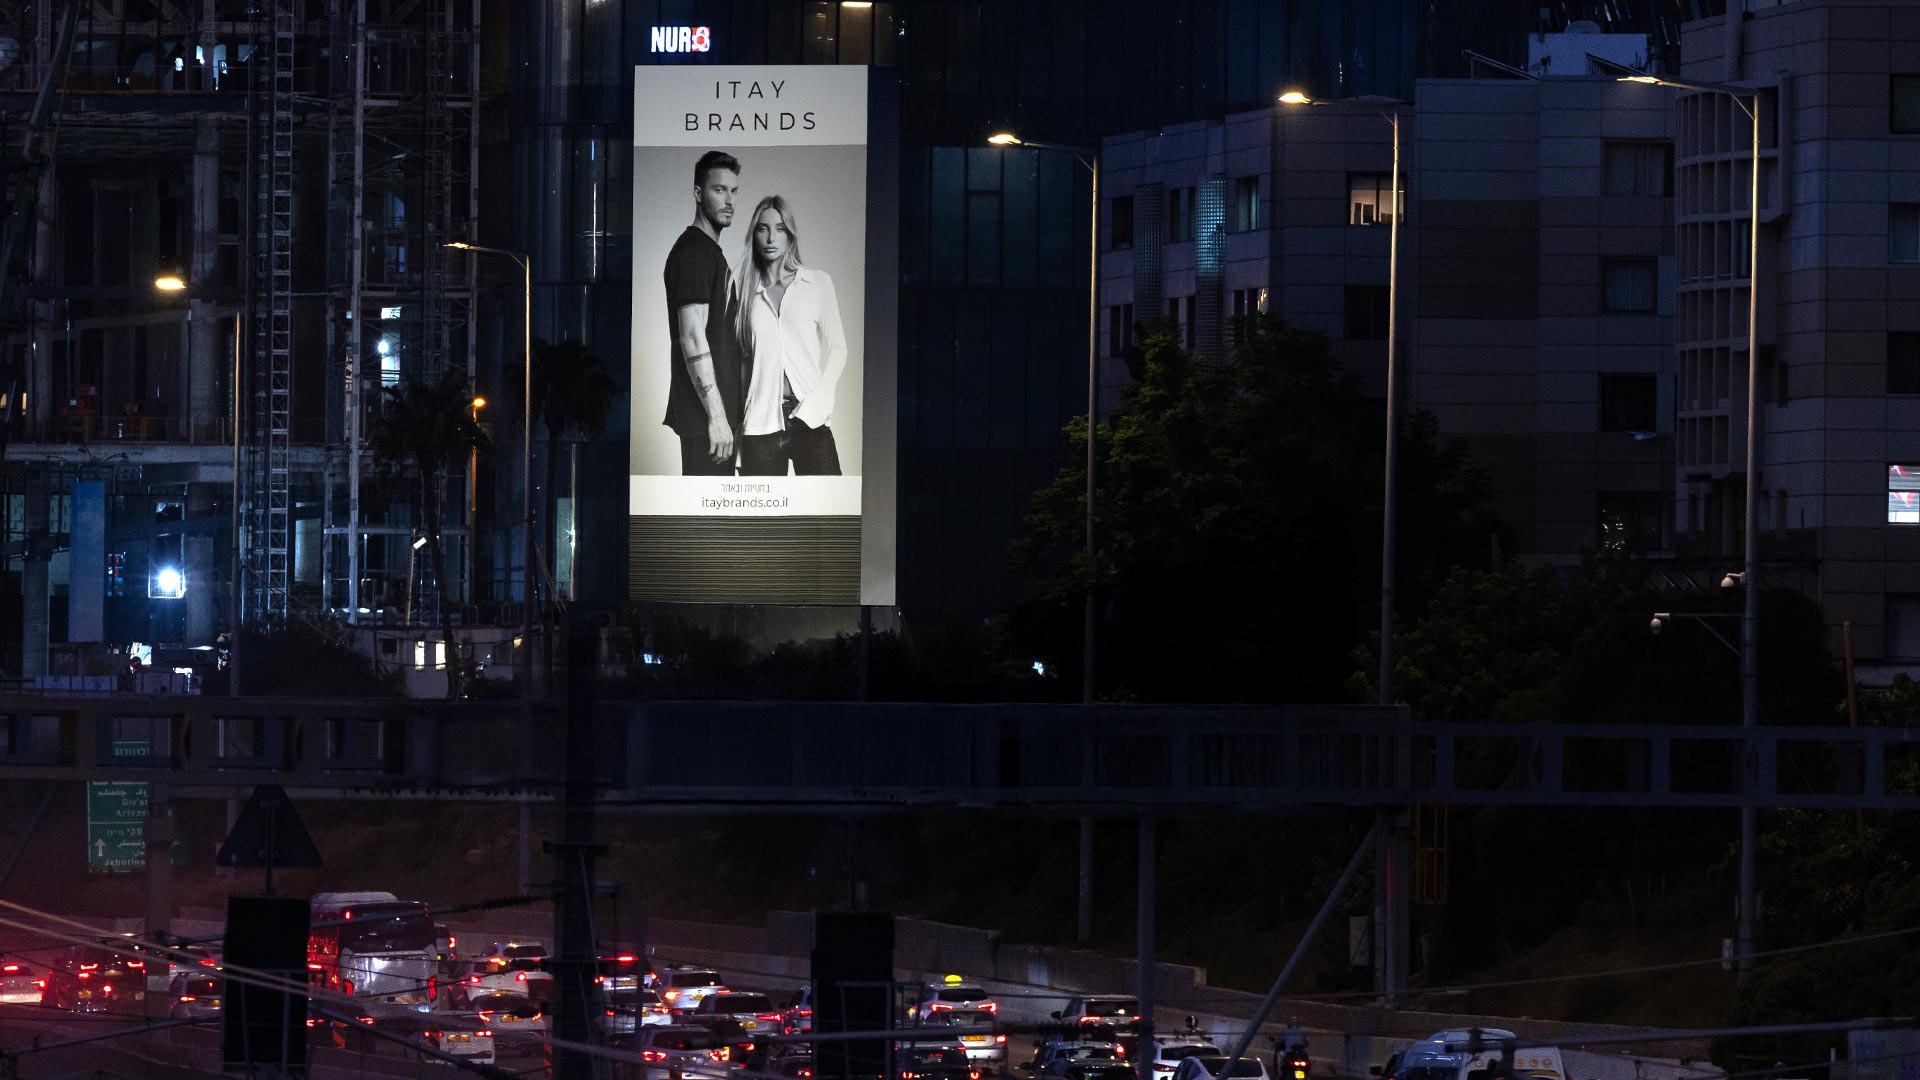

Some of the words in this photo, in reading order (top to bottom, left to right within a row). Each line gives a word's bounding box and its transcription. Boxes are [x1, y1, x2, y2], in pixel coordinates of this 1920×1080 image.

[715, 80, 786, 99] ITAY
[685, 111, 817, 131] BRANDS
[702, 496, 789, 510] itaybrands.co.il
[104, 858, 146, 866] Jabotins
